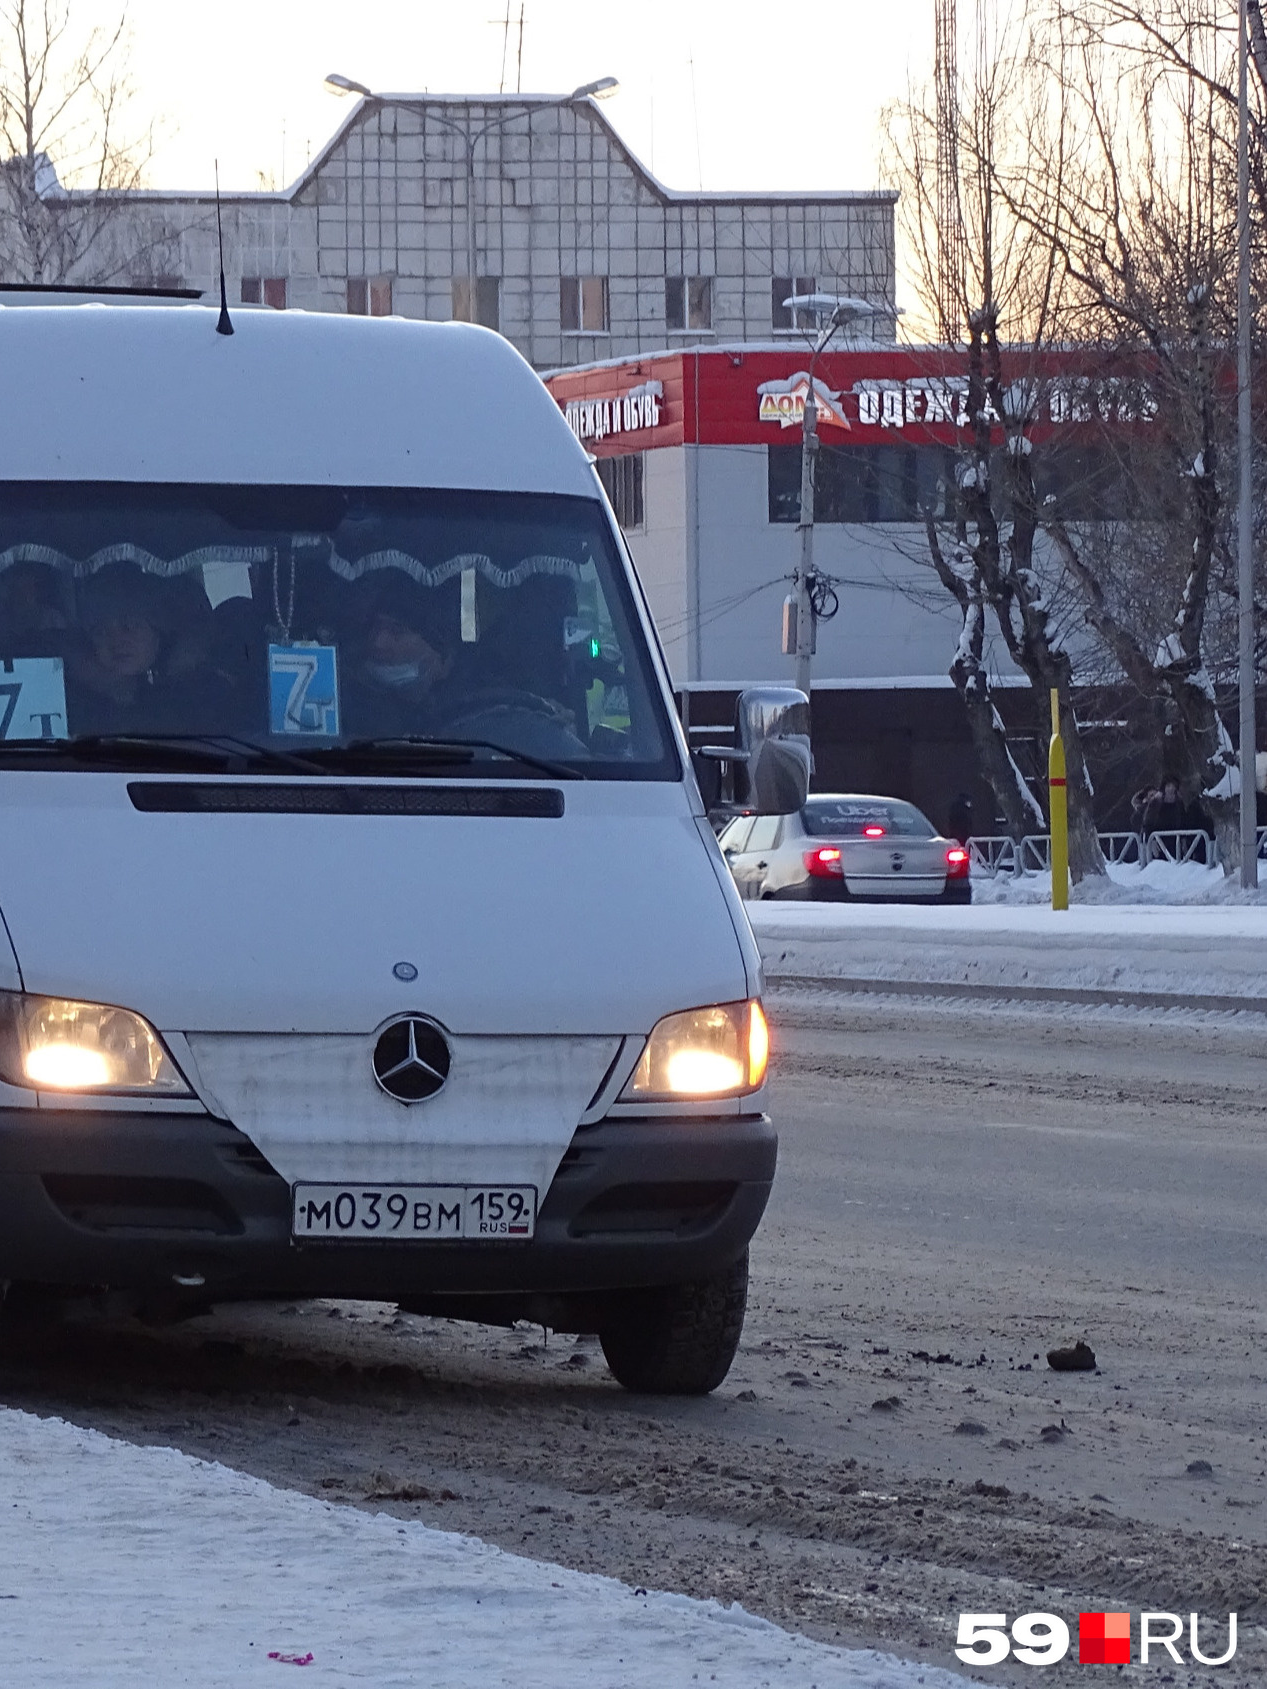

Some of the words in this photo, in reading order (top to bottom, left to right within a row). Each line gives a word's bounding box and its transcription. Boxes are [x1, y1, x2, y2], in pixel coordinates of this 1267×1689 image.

[613, 399, 622, 434] И
[623, 394, 660, 432] ОБУВЬ
[470, 1192, 525, 1221] 159
[479, 1222, 508, 1233] RUS
